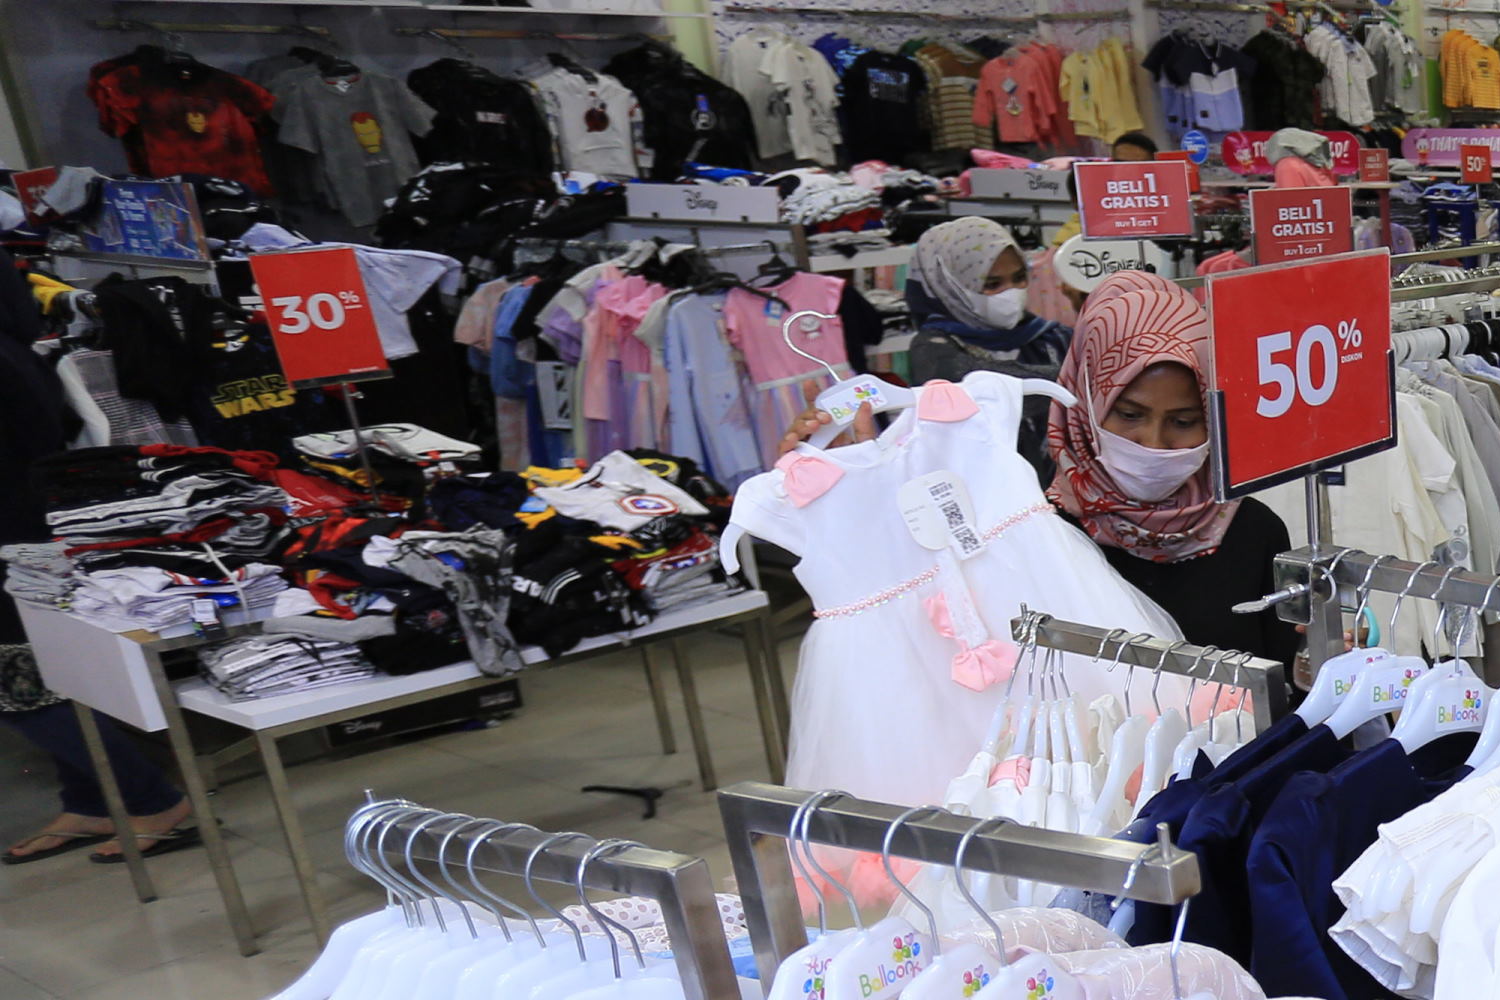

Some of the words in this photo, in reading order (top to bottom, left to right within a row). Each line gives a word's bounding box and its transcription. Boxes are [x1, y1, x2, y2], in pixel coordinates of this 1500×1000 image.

[1430, 136, 1468, 152] THAT'S
[1106, 181, 1143, 194] BELI
[1143, 173, 1157, 193] 1
[1100, 196, 1160, 209] GRATIS
[1161, 195, 1169, 207] 1
[1278, 207, 1311, 221] BELI
[1312, 199, 1323, 220] 1
[1272, 222, 1325, 237] GRATIS
[1326, 221, 1334, 234] 1
[1284, 247, 1298, 256] BUY
[1297, 245, 1304, 255] 1
[1304, 246, 1317, 255] GET
[1317, 243, 1323, 253] 1
[1341, 352, 1363, 364] DISKON
[210, 373, 286, 403] STAR
[214, 388, 296, 419] WARS
